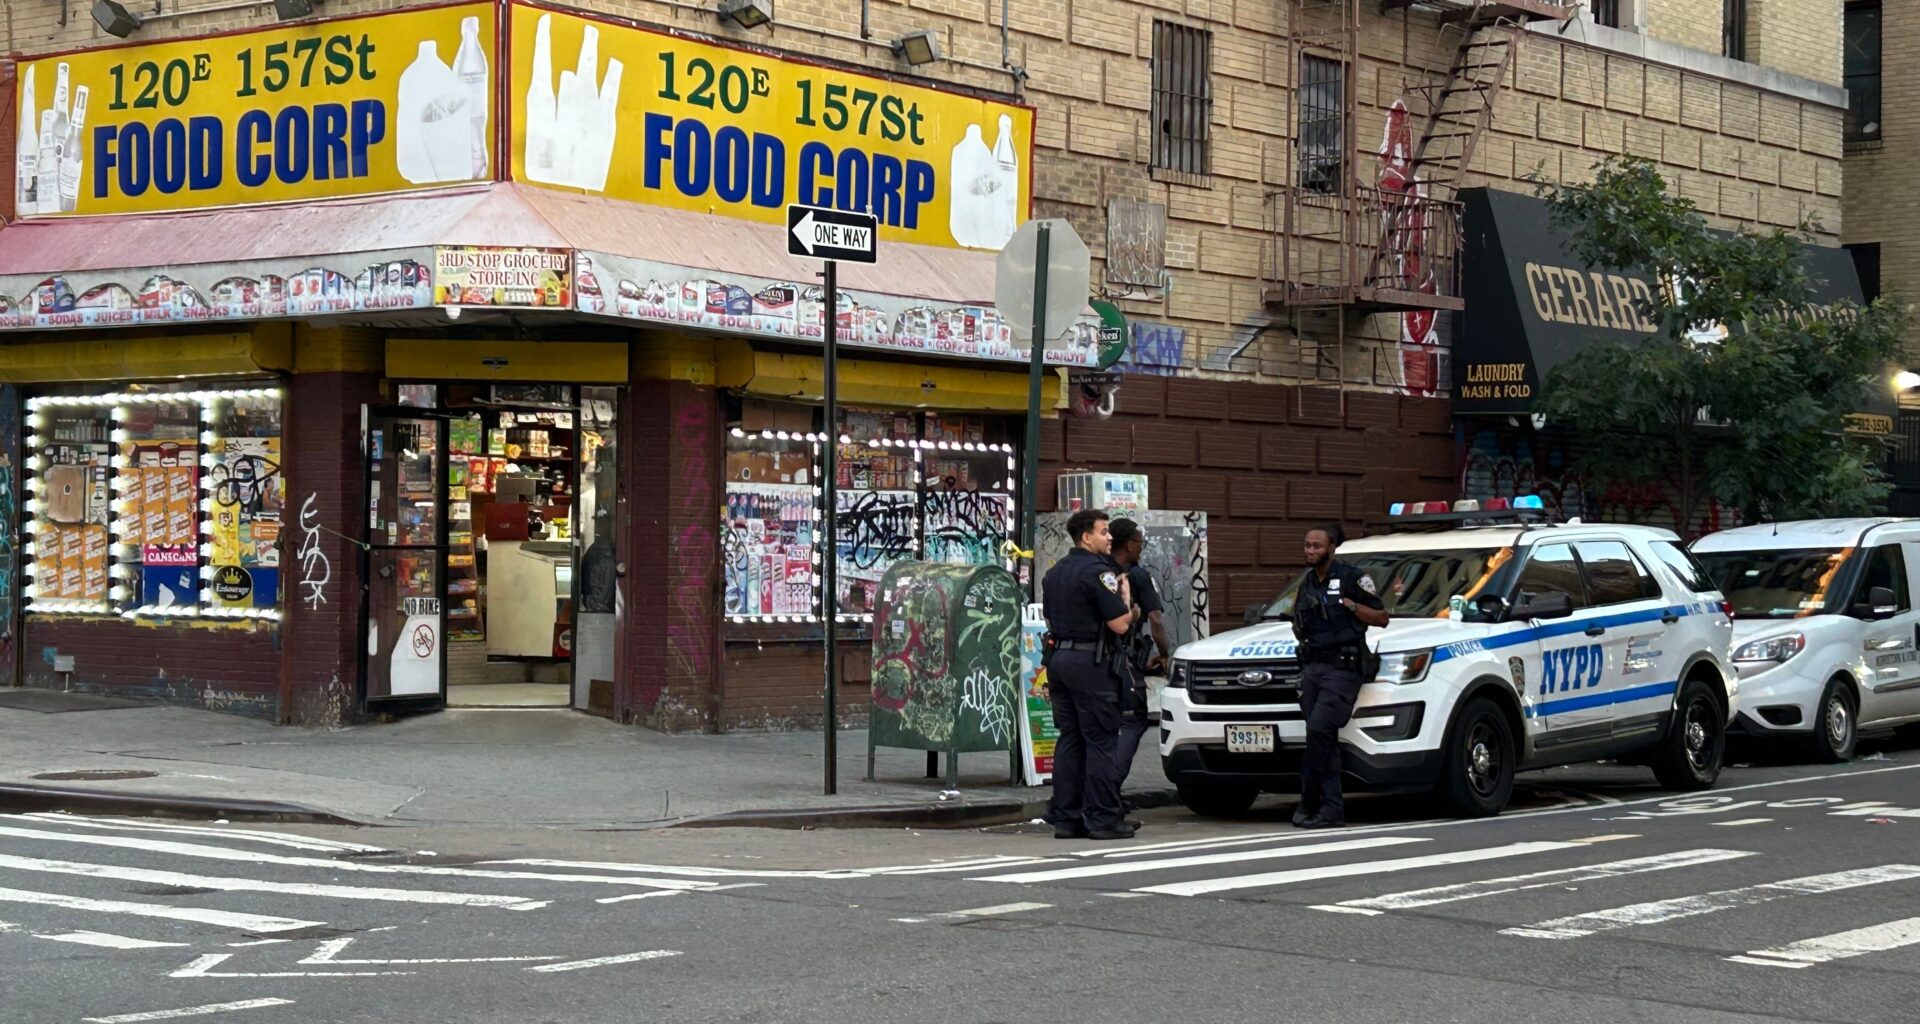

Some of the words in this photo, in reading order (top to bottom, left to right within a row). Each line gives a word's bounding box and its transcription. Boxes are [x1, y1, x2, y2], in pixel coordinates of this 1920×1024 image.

[236, 33, 377, 98] 157St
[796, 79, 925, 146] 157St
[94, 116, 223, 198] FOOD
[236, 99, 385, 188] CORP
[644, 112, 785, 208] FOOD
[799, 141, 934, 229] CORP
[815, 224, 838, 245] ONE
[843, 227, 867, 248] WAY
[439, 254, 464, 268] 3RD
[467, 254, 500, 268] STOP
[504, 254, 567, 269] GROCERY
[469, 271, 512, 286] STORE
[515, 272, 539, 286] INC
[1525, 261, 1659, 333] GERARD
[0, 314, 36, 327] ROCERY
[48, 313, 84, 325] SODAS
[94, 310, 133, 323] JUICES
[144, 307, 171, 320] MILK
[183, 306, 229, 318] SNACKS
[327, 298, 352, 311] TEA
[364, 294, 414, 308] CANDYS
[638, 306, 704, 323] GROCERY
[1467, 363, 1526, 382] LAUNDRY
[1461, 385, 1491, 398] WASH
[1493, 385, 1501, 398] &
[1504, 384, 1531, 398] FOLD
[216, 583, 250, 595] Entourage
[404, 599, 417, 615] NO
[419, 599, 440, 615] BIKE
[1229, 645, 1298, 657] POLICE
[1450, 640, 1482, 658] POLICE
[1540, 643, 1604, 696] NYPD
